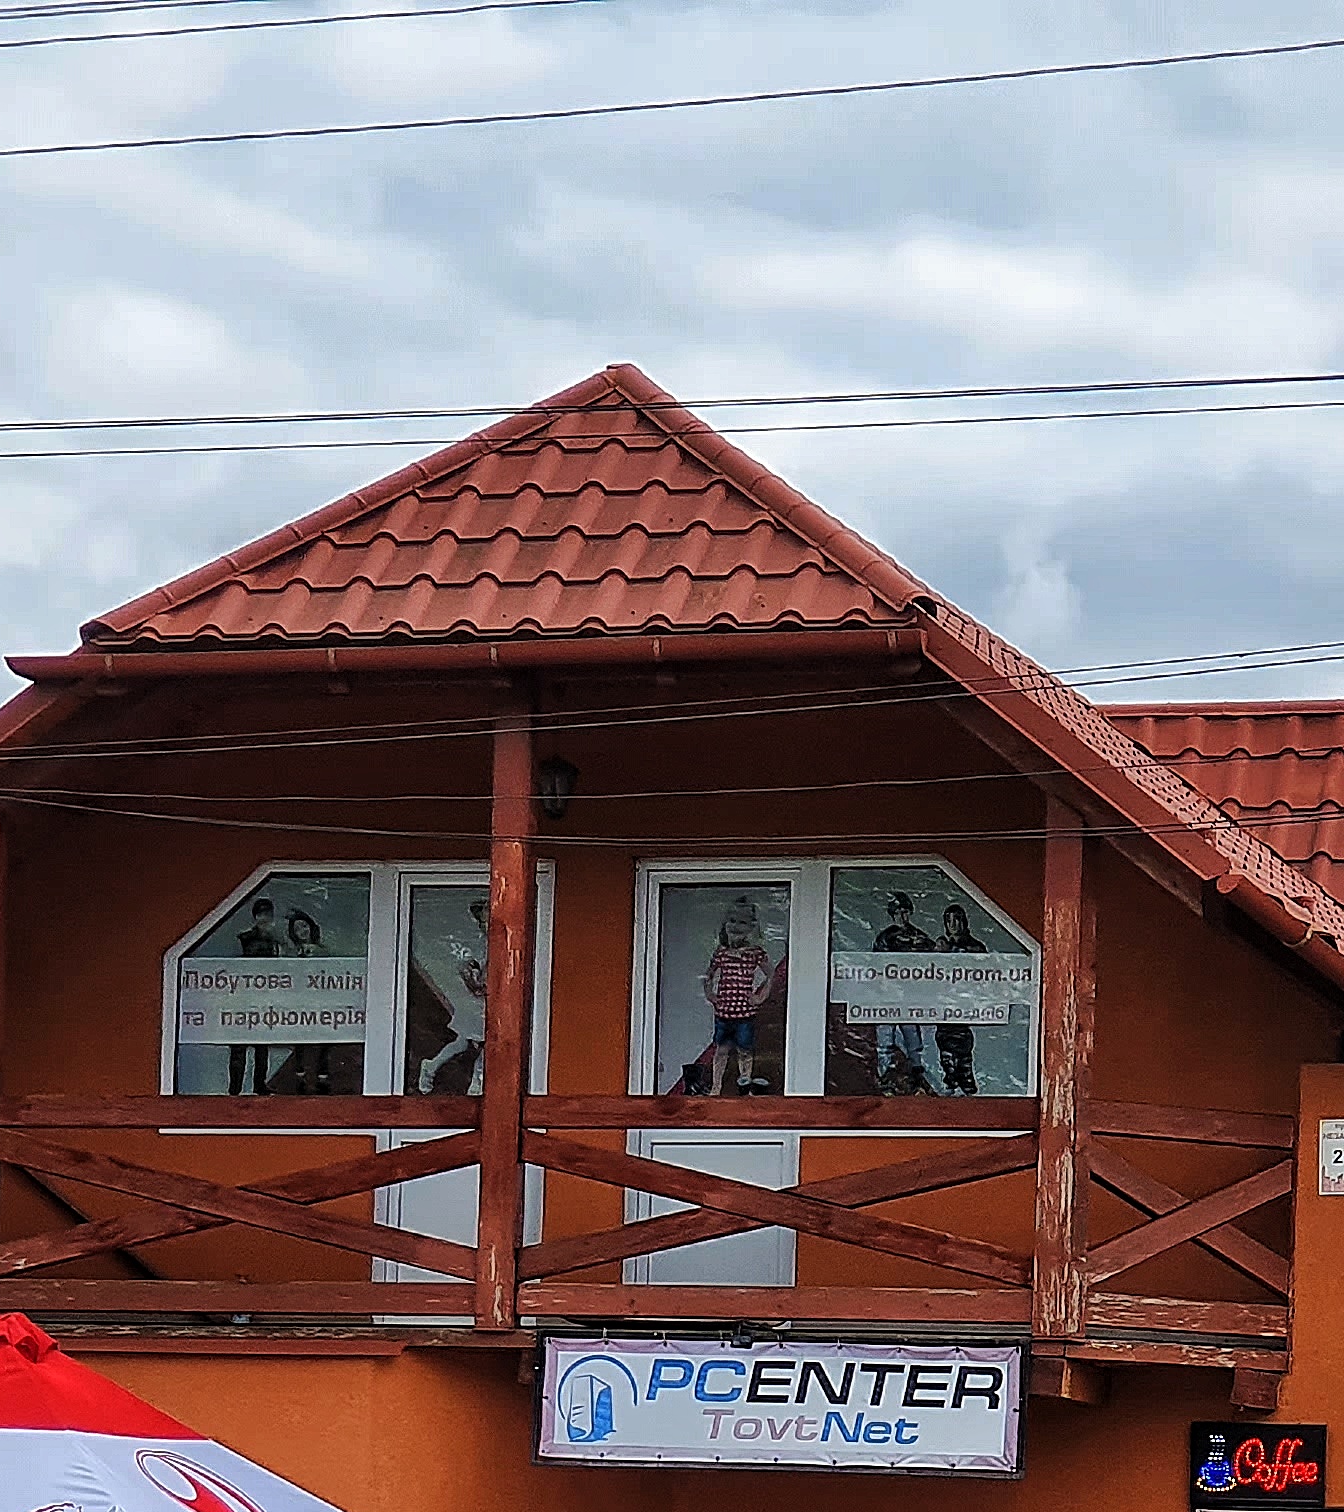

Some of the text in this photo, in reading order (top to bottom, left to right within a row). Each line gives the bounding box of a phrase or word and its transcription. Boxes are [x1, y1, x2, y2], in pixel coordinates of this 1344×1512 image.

[183, 970, 363, 994] Побутова хімія
[833, 962, 1032, 984] Euro-Goods.prom.ua
[183, 1011, 205, 1026] та
[850, 1005, 901, 1018] Оптом
[645, 1358, 1004, 1410] PCENTER
[702, 1408, 919, 1445] TovtNet
[1233, 1437, 1319, 1492] Coffee
